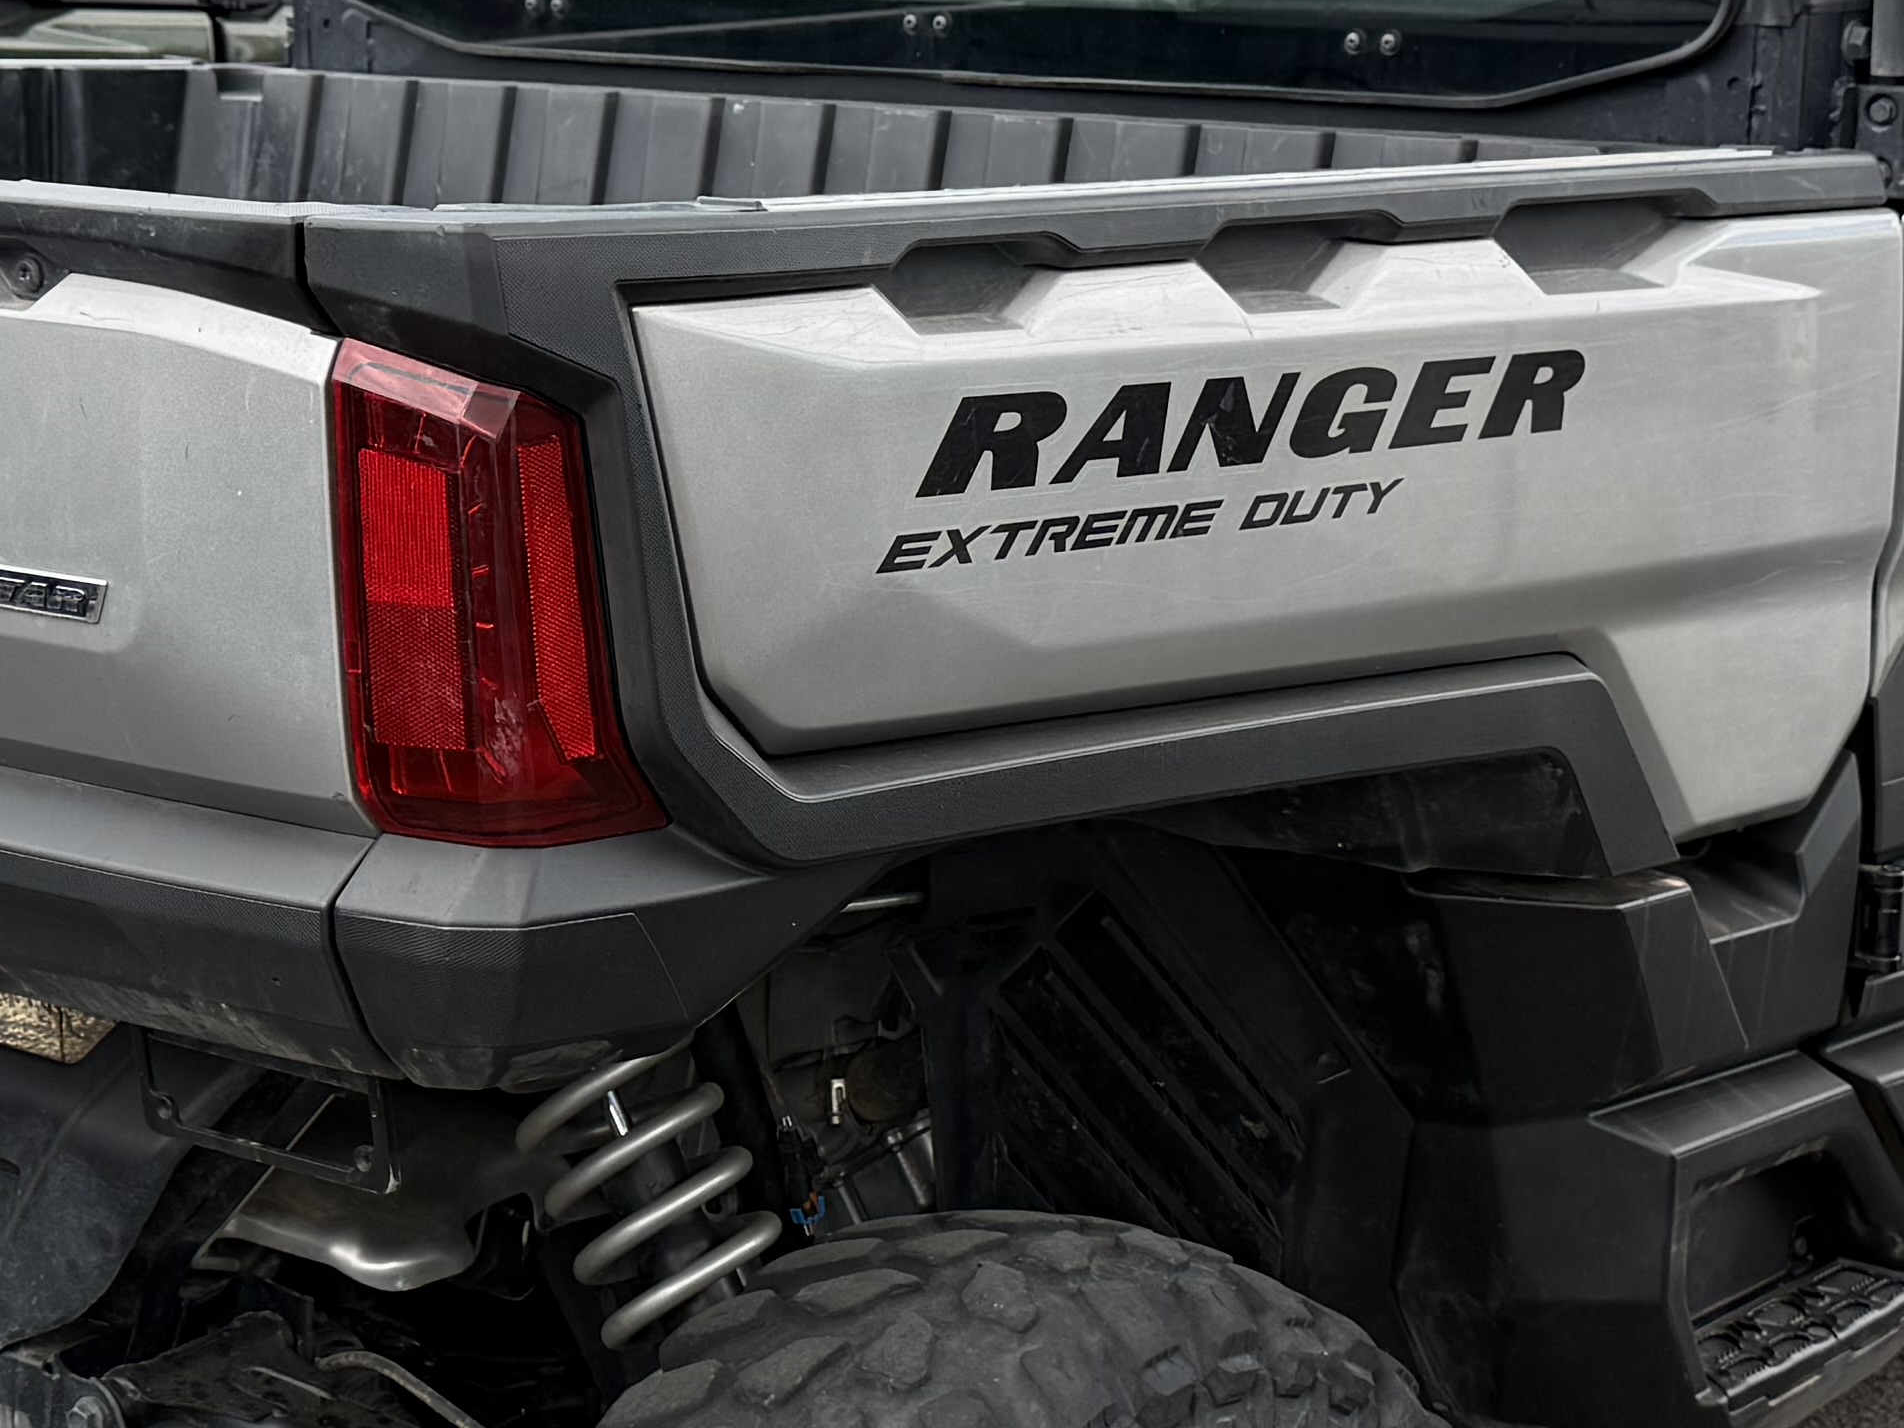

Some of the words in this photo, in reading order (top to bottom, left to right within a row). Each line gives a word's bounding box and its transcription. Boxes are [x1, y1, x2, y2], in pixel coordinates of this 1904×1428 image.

[914, 348, 1587, 500] RANGER
[874, 498, 1224, 576] EXTREME
[1239, 475, 1408, 533] DUTY
